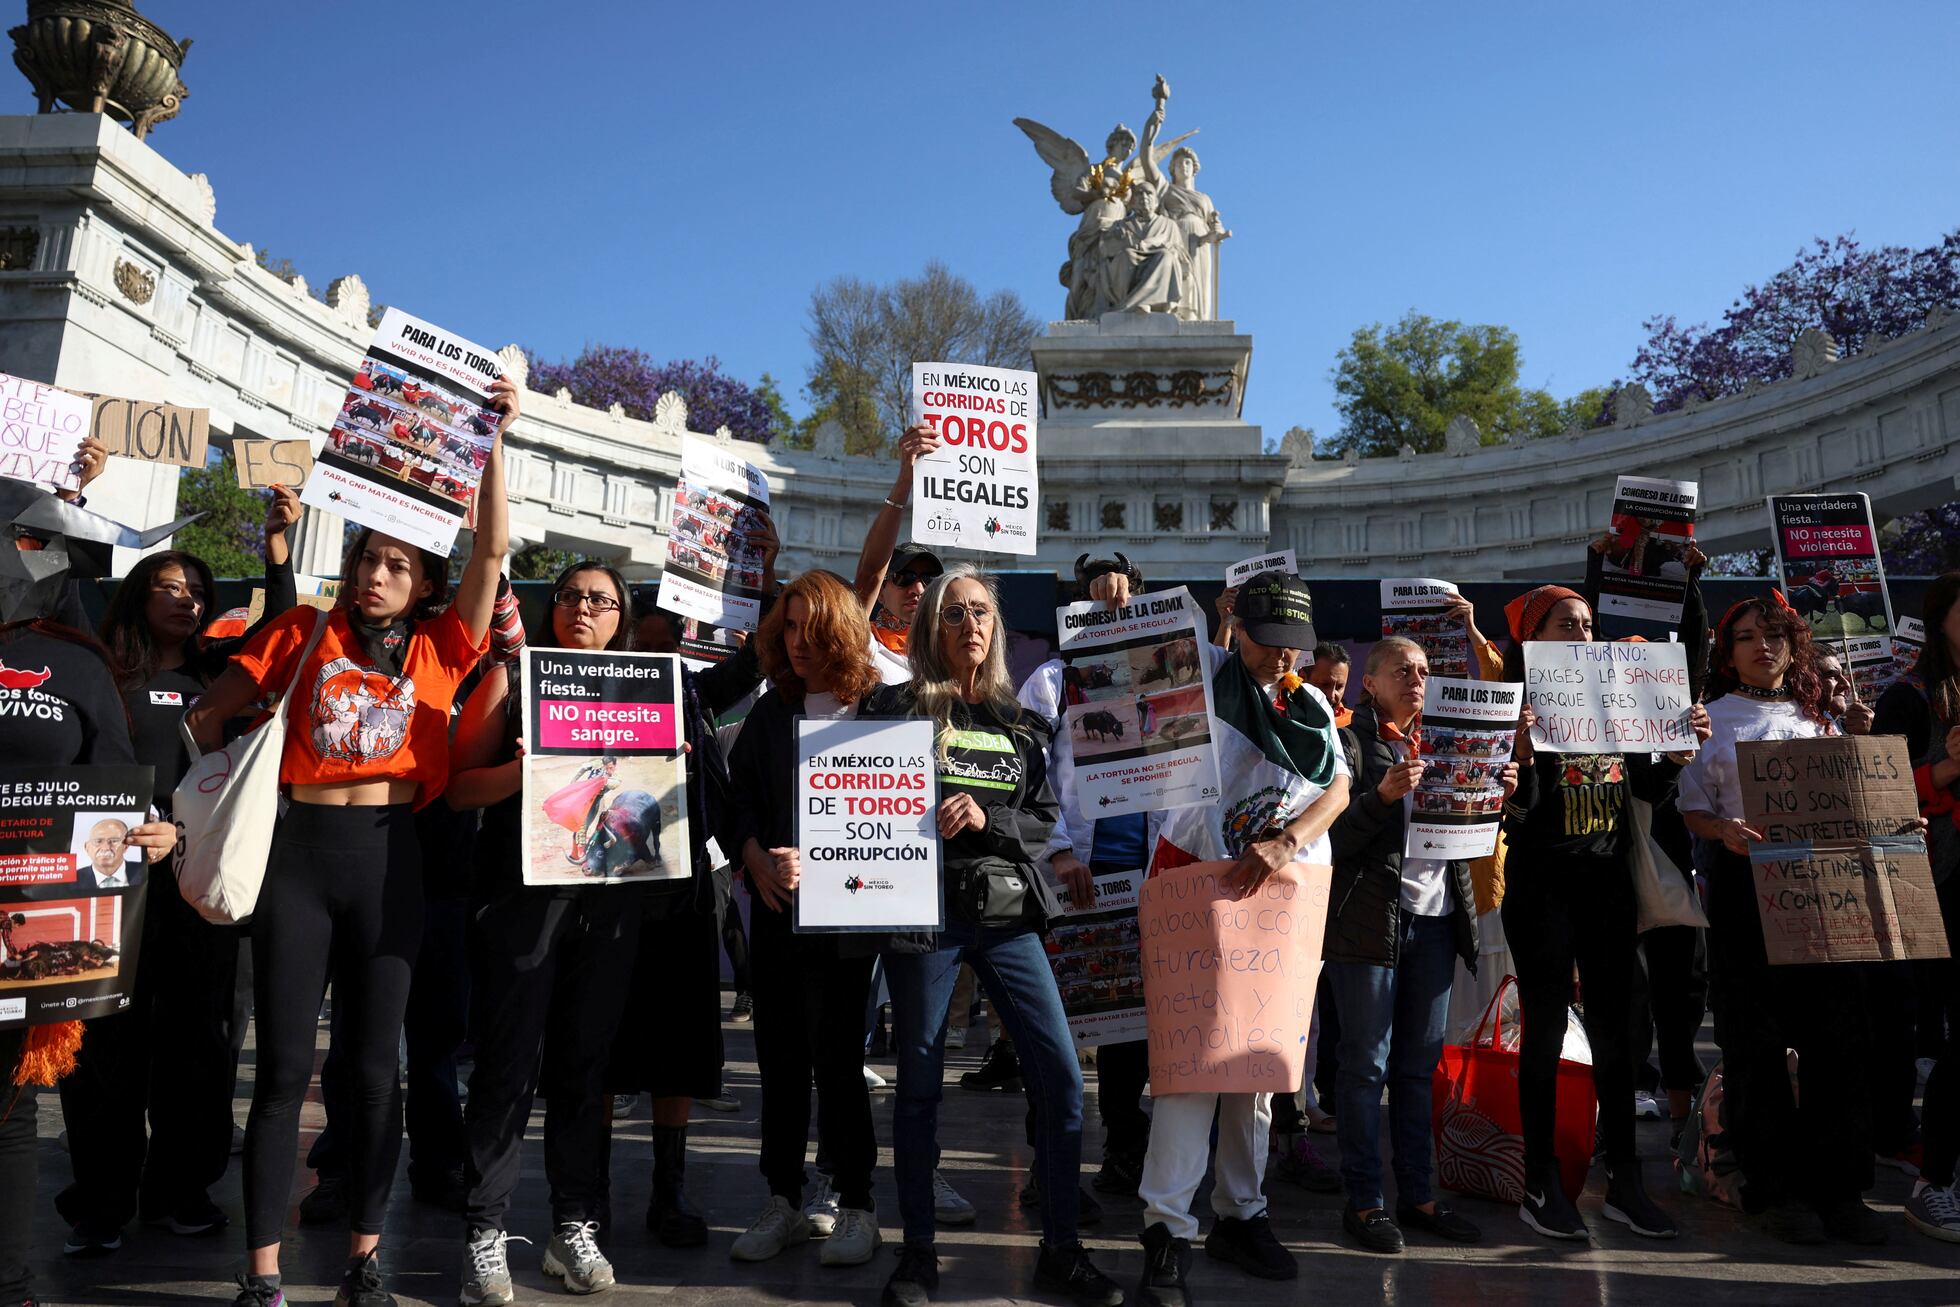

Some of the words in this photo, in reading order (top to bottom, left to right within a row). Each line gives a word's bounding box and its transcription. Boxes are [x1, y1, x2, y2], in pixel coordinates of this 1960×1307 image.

[391, 341, 417, 357] VIVIR
[418, 354, 434, 364] NO
[436, 361, 448, 371] ES
[401, 324, 437, 351] PARA
[437, 340, 462, 361] LOS
[463, 351, 502, 381] TOROS
[922, 372, 940, 387] EN
[944, 372, 1000, 392] MÉXICO
[1004, 380, 1028, 396] LAS
[923, 391, 1005, 414] CORRIDAS
[1010, 400, 1027, 417] DE
[3, 398, 81, 434] BELLO
[2, 421, 61, 456] QUE
[923, 414, 1028, 454] TOROS
[244, 440, 305, 487] ES
[959, 454, 995, 476] SON
[737, 464, 760, 486] TOROS
[323, 470, 347, 484] PARA
[348, 480, 367, 491] GNP
[368, 488, 399, 504] MATAR
[399, 499, 413, 510] ES
[411, 503, 454, 526] INCREÍBLE
[923, 476, 1029, 510] ILEGALES
[1621, 487, 1658, 500] CONGRESO
[1659, 492, 1669, 501] DE
[1669, 494, 1678, 503] LA
[1780, 503, 1801, 512] Una
[1803, 500, 1857, 511] verdadera
[1781, 514, 1821, 525] fiesta...
[1790, 529, 1809, 540] NO
[1813, 527, 1862, 539] necesita
[1799, 540, 1857, 553] violencia.
[1234, 564, 1250, 576] PARA
[1251, 560, 1264, 571] LOS
[1265, 556, 1286, 569] TOROS
[1248, 587, 1267, 595] ALTO
[1393, 585, 1413, 596] PARA
[1414, 585, 1428, 596] LOS
[1065, 609, 1117, 630] CONGRESO
[1118, 606, 1133, 620] DE
[1135, 602, 1149, 617] LA
[1151, 596, 1184, 615] CDMX
[1090, 626, 1127, 639] TORTURA
[1128, 624, 1139, 632] SE
[1140, 616, 1178, 630] REGULA?
[1567, 644, 1647, 662] TAURINO:
[1860, 640, 1882, 651] TOROS
[540, 660, 573, 676] Una
[578, 663, 660, 680] verdadera
[1529, 667, 1584, 684] EXIGES
[1599, 668, 1617, 684] LA
[1624, 667, 1687, 685] SANGRE
[540, 680, 601, 698] fiesta...
[1442, 686, 1468, 701] PARA
[1470, 689, 1489, 704] LOS
[1491, 690, 1515, 705] TOROS
[1529, 691, 1586, 708] PORQUE
[1601, 692, 1637, 708] ERES
[1655, 696, 1681, 710] UN
[0, 700, 63, 722] VIVOS
[549, 704, 579, 721] NO
[585, 707, 660, 723] necesita
[1436, 705, 1457, 713] VIVIR
[1483, 709, 1513, 717] INCREÍBLE
[571, 728, 640, 745] sangre.
[1535, 713, 1598, 744] SÁDICO
[809, 756, 828, 768] EN
[832, 753, 894, 768] MÉXICO
[899, 756, 925, 768] LAS
[1752, 752, 1797, 782] LOS
[1806, 752, 1899, 781] ANIMALES
[1100, 767, 1140, 779] TORTURA
[1141, 765, 1154, 773] NO
[1155, 762, 1166, 771] SE
[1121, 777, 1132, 785] SE
[1134, 770, 1172, 784] PROHIBE!
[15, 783, 32, 793] ES
[36, 781, 80, 793] JULIO
[809, 773, 926, 790] CORRIDAS
[56, 793, 136, 807] SACRISTÁN
[809, 797, 836, 815] DE
[844, 797, 926, 815] TOROS
[1765, 790, 1798, 813] NO
[1808, 790, 1850, 812] SON
[40, 817, 54, 827] DE
[846, 822, 891, 840] SON
[809, 844, 928, 861] CORRUPCIÓN
[6, 866, 38, 874] permite
[37, 872, 63, 880] maten
[1102, 879, 1132, 896] TOROS
[1257, 908, 1309, 941] con
[1246, 1054, 1276, 1079] las
